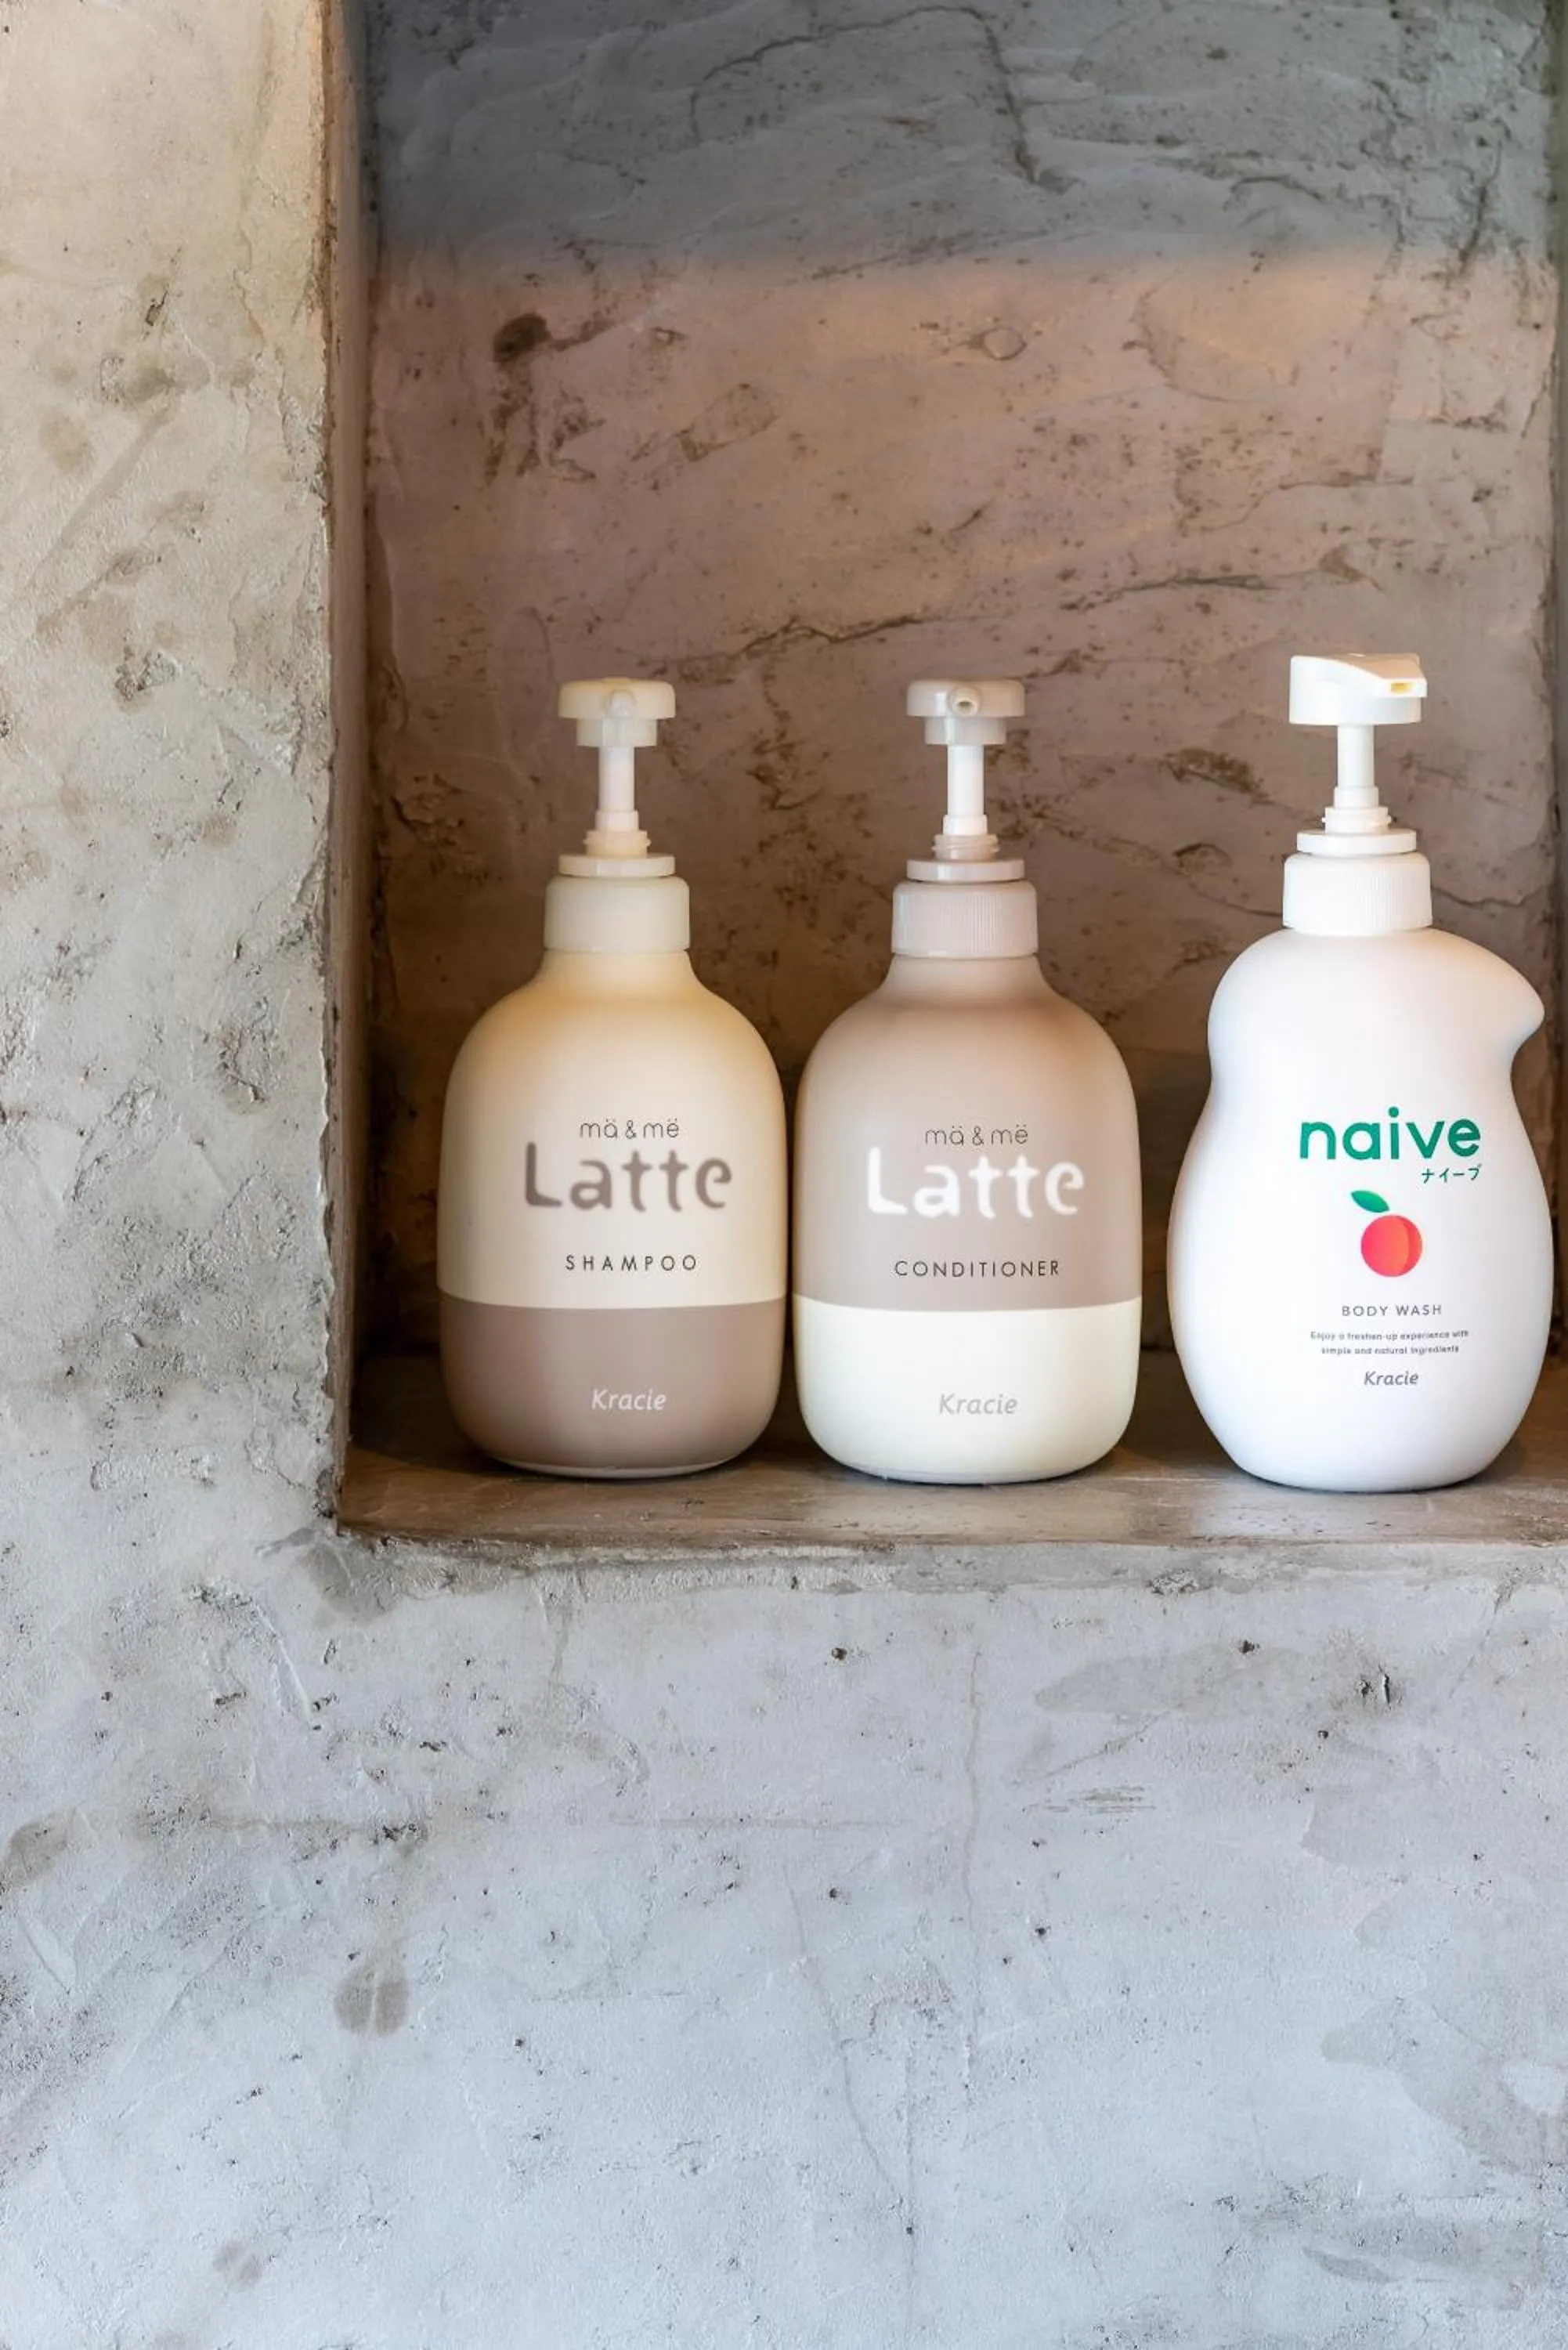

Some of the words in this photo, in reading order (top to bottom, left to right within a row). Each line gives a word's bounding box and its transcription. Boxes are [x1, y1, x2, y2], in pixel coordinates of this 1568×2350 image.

[1300, 1106, 1481, 1160] naive
[525, 1141, 732, 1212] Latte
[867, 1146, 1085, 1219] Latte
[565, 1254, 697, 1271] SHAMPOO
[894, 1260, 1060, 1277] CONDITIONER
[1342, 1306, 1388, 1317] BODY
[1396, 1304, 1442, 1316] WASH
[1310, 1331, 1335, 1342] Enjoy
[1400, 1332, 1449, 1341] experience
[1321, 1347, 1352, 1356] simple
[1411, 1345, 1459, 1355] ingredients
[1364, 1371, 1419, 1386] Kracie
[591, 1389, 667, 1411] Kracie
[939, 1393, 1018, 1415] Kracie
